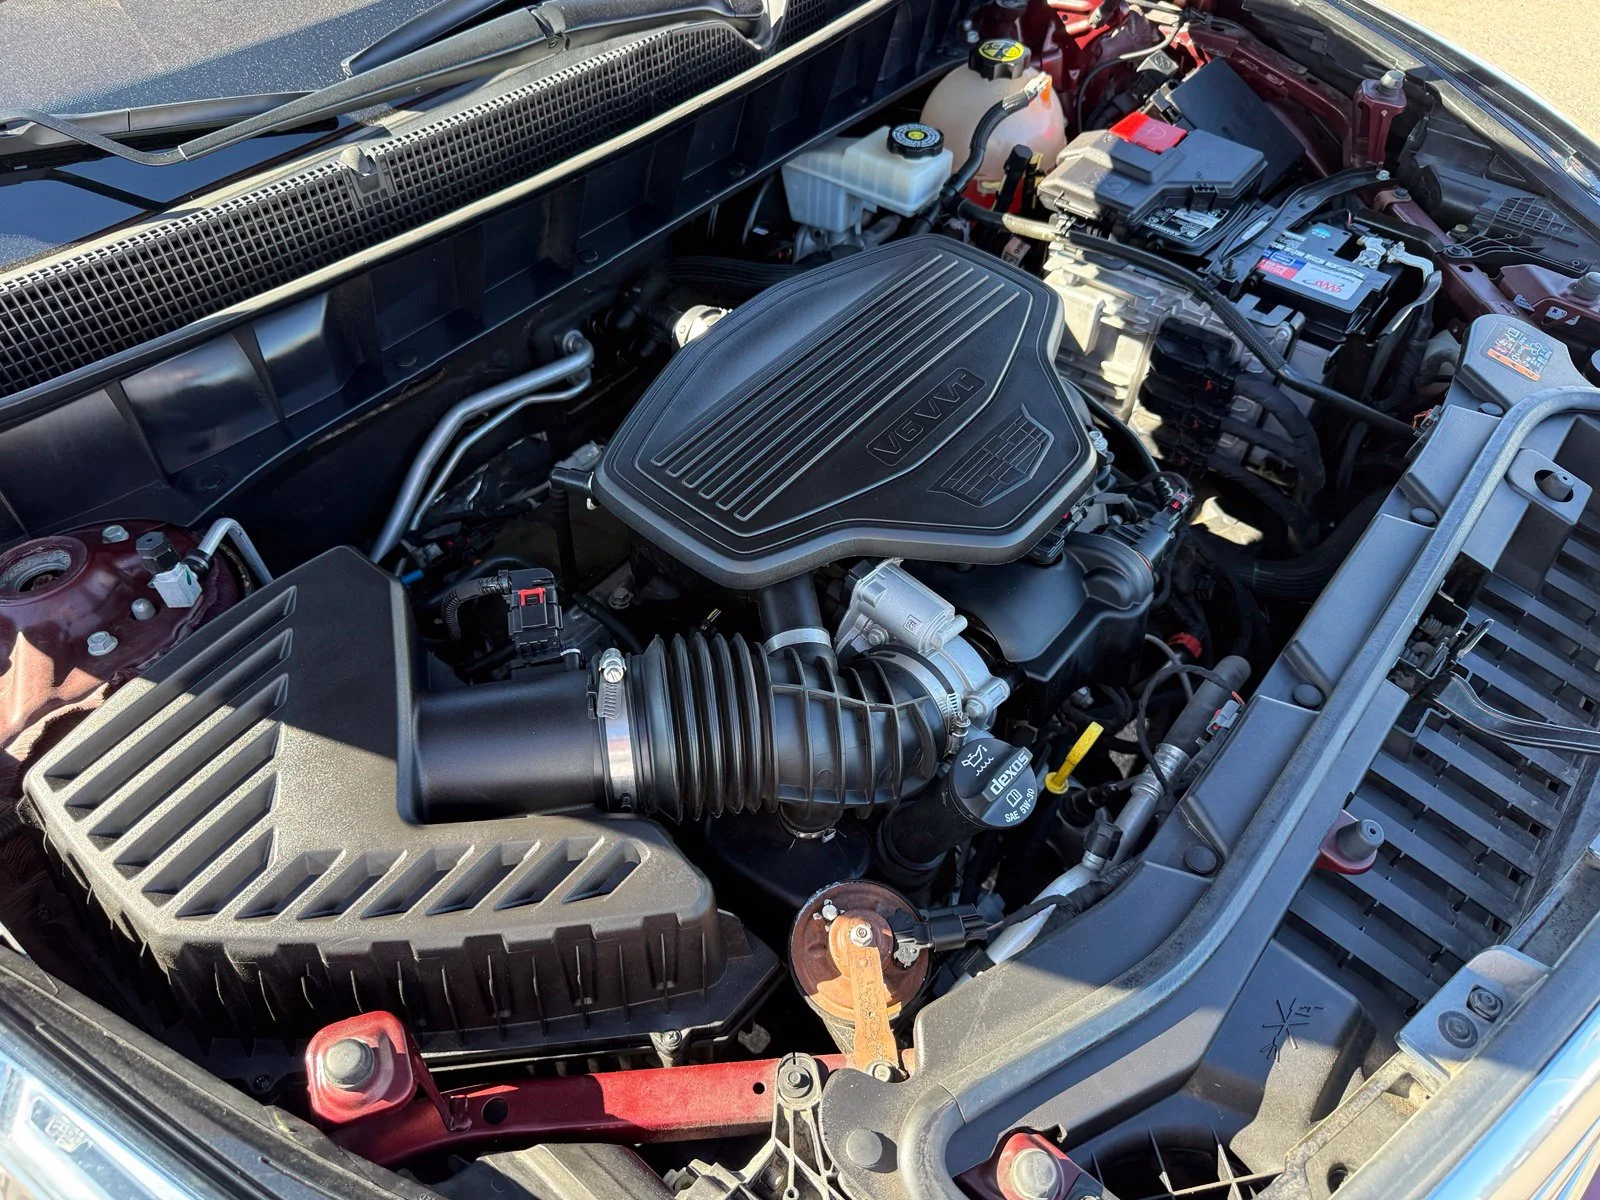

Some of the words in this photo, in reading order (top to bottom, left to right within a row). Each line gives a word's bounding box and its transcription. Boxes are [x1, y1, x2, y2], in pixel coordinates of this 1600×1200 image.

[873, 419, 924, 455] V6
[914, 374, 974, 420] VVT
[990, 751, 1029, 795] dexos
[1004, 810, 1020, 823] SAE
[1019, 788, 1035, 814] 5W-30
